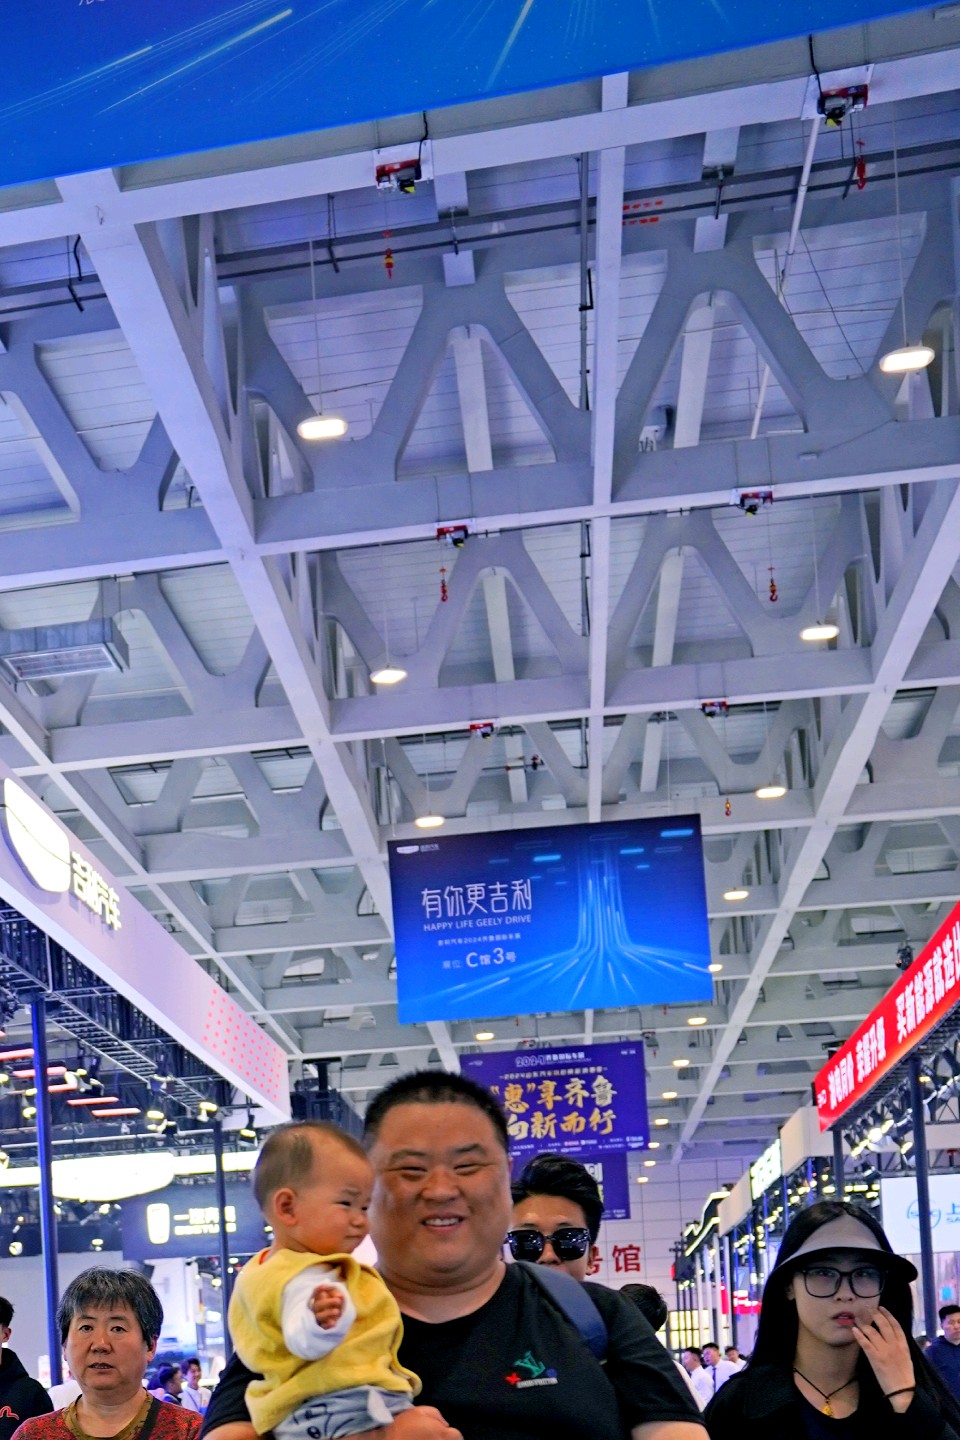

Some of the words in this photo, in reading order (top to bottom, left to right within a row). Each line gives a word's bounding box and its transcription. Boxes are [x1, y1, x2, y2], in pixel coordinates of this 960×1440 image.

[421, 879, 532, 919] 有你更吉利
[424, 921, 453, 931] HAPPY
[456, 919, 474, 929] LIFE
[476, 917, 502, 927] GEELY
[505, 914, 532, 924] DRIVE
